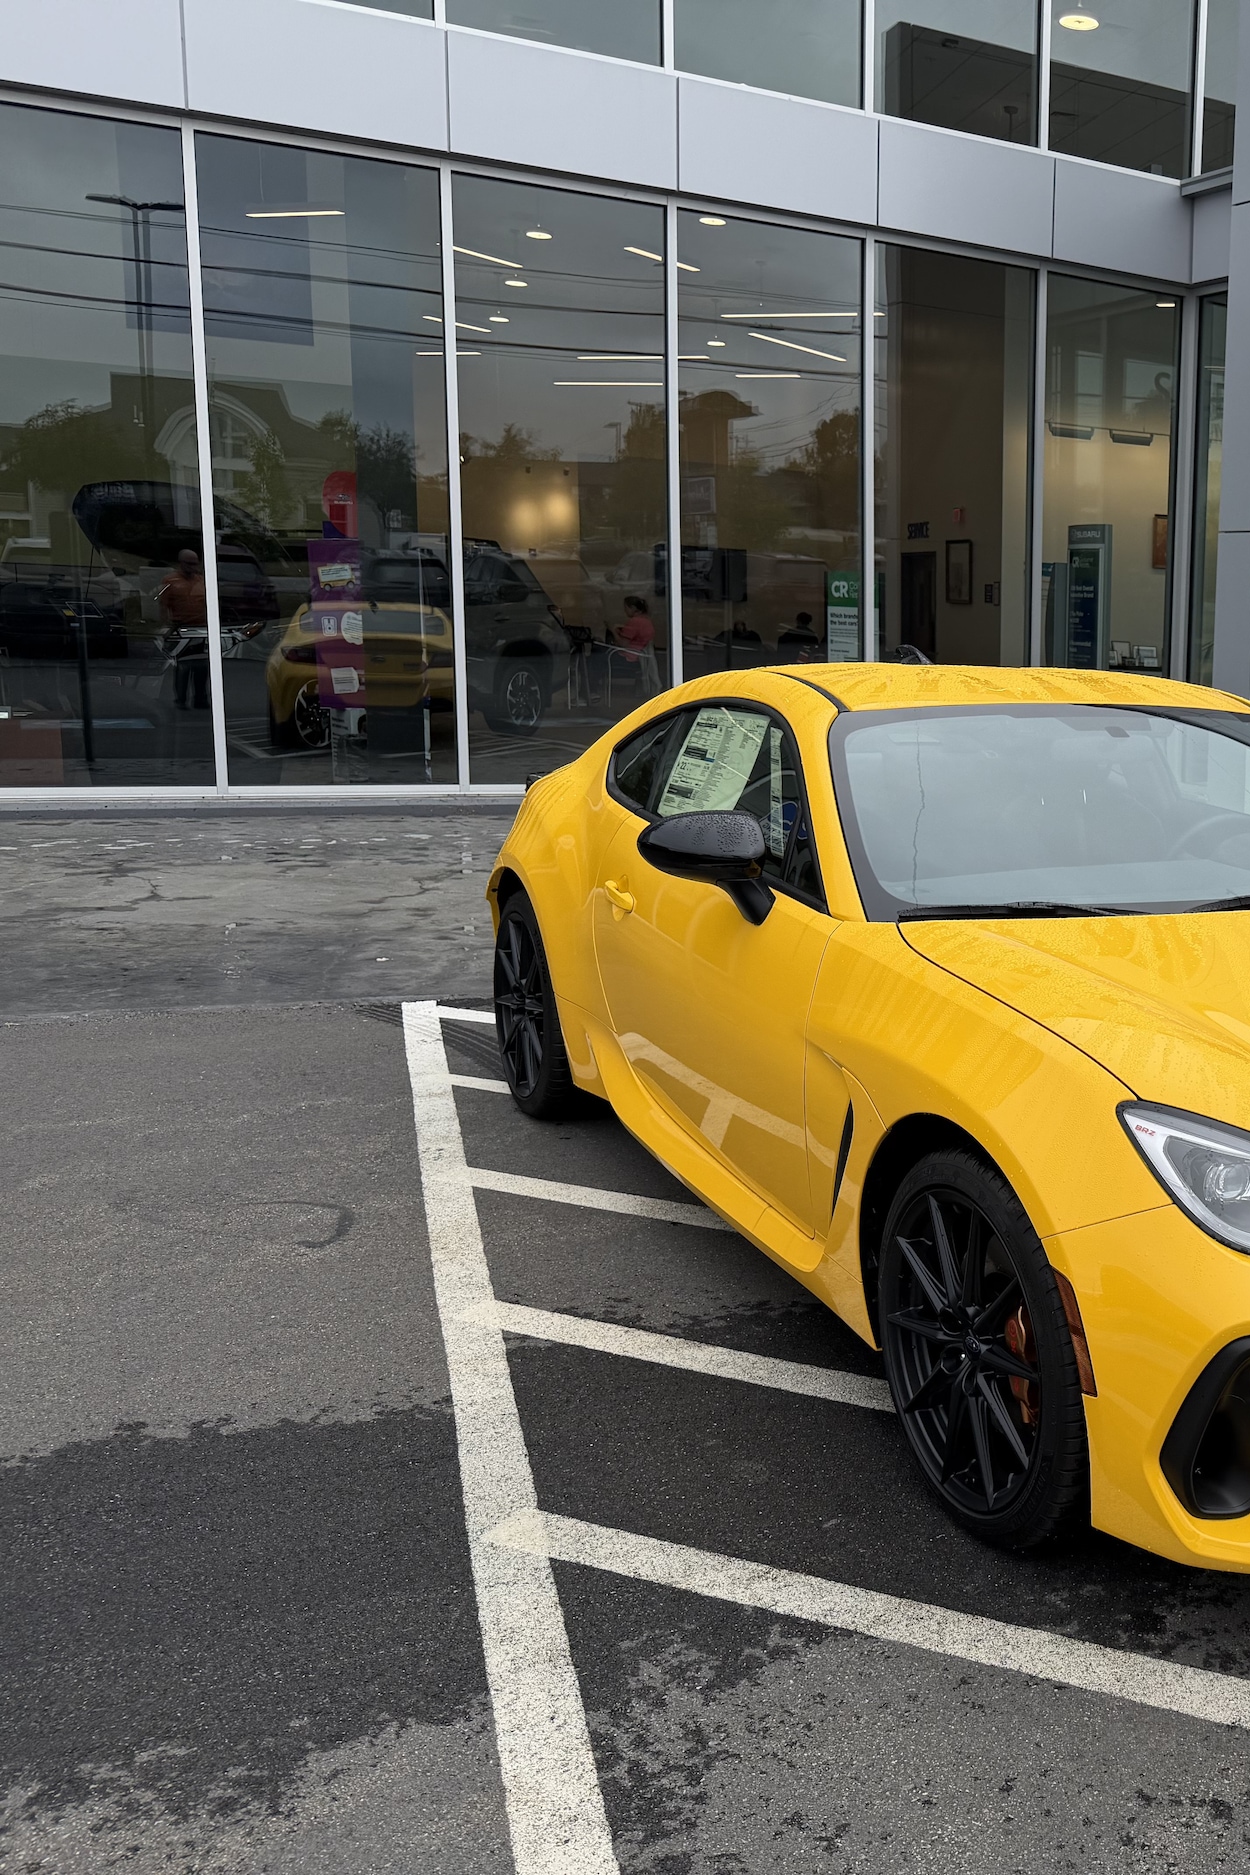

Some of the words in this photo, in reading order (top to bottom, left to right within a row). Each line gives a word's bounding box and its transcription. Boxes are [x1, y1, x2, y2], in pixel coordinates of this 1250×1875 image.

[1077, 530, 1100, 538] SUBARU
[831, 581, 848, 598] CR
[1134, 1124, 1156, 1137] BRZ
